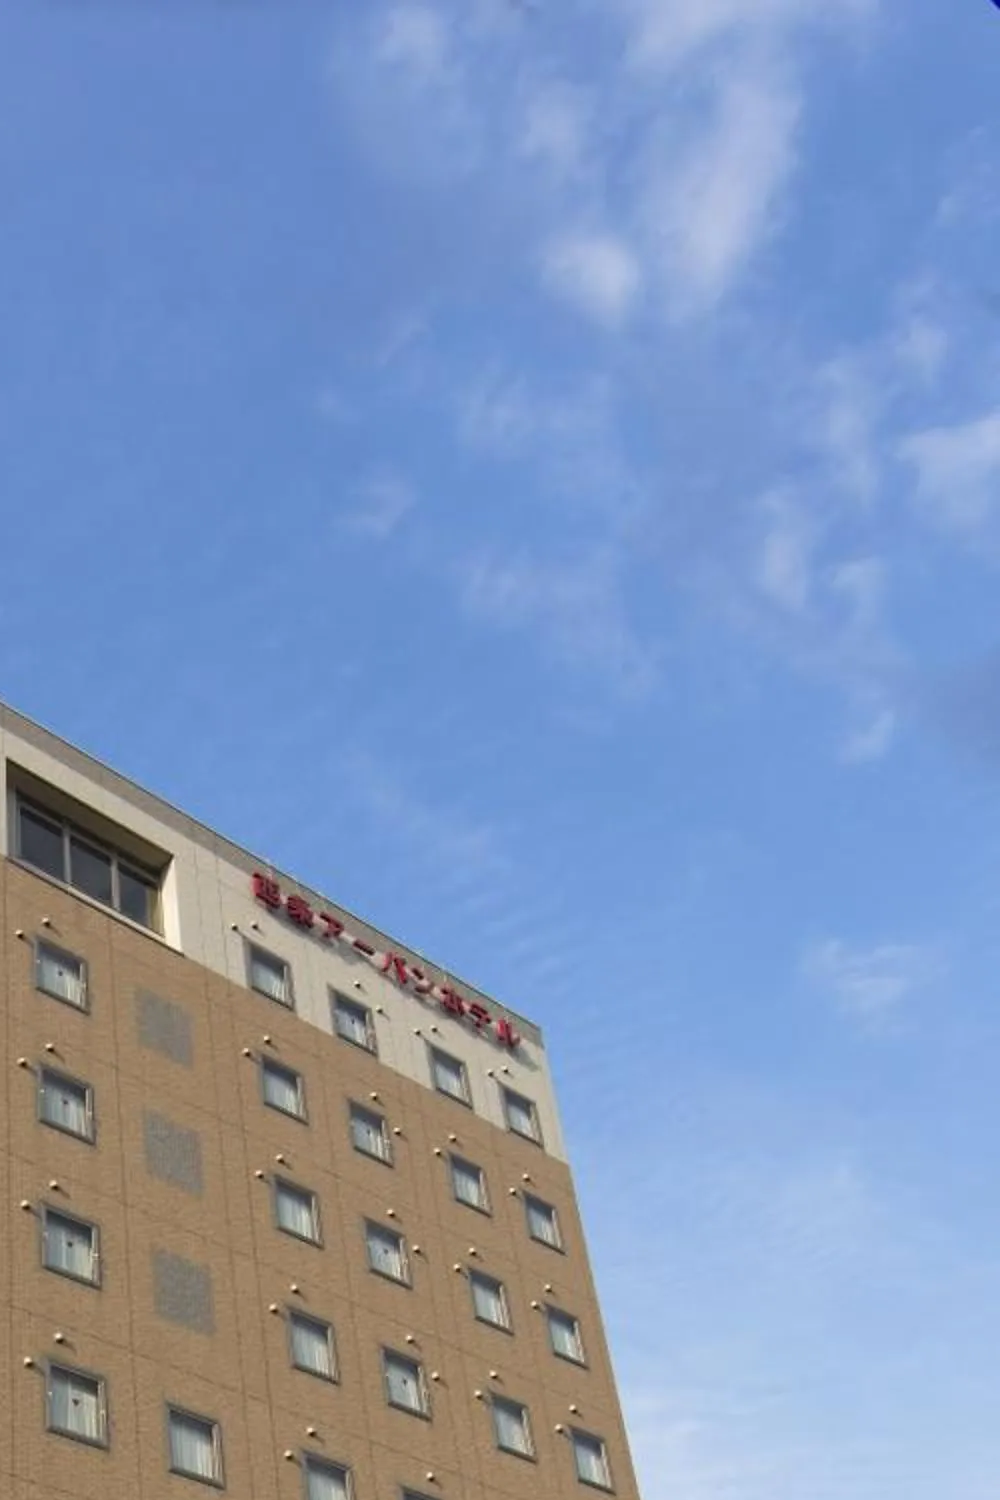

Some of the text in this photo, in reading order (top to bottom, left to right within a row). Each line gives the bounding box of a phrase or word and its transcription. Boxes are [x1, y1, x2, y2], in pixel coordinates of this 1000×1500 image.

[252, 871, 521, 1048] 西条アーバンホテル
